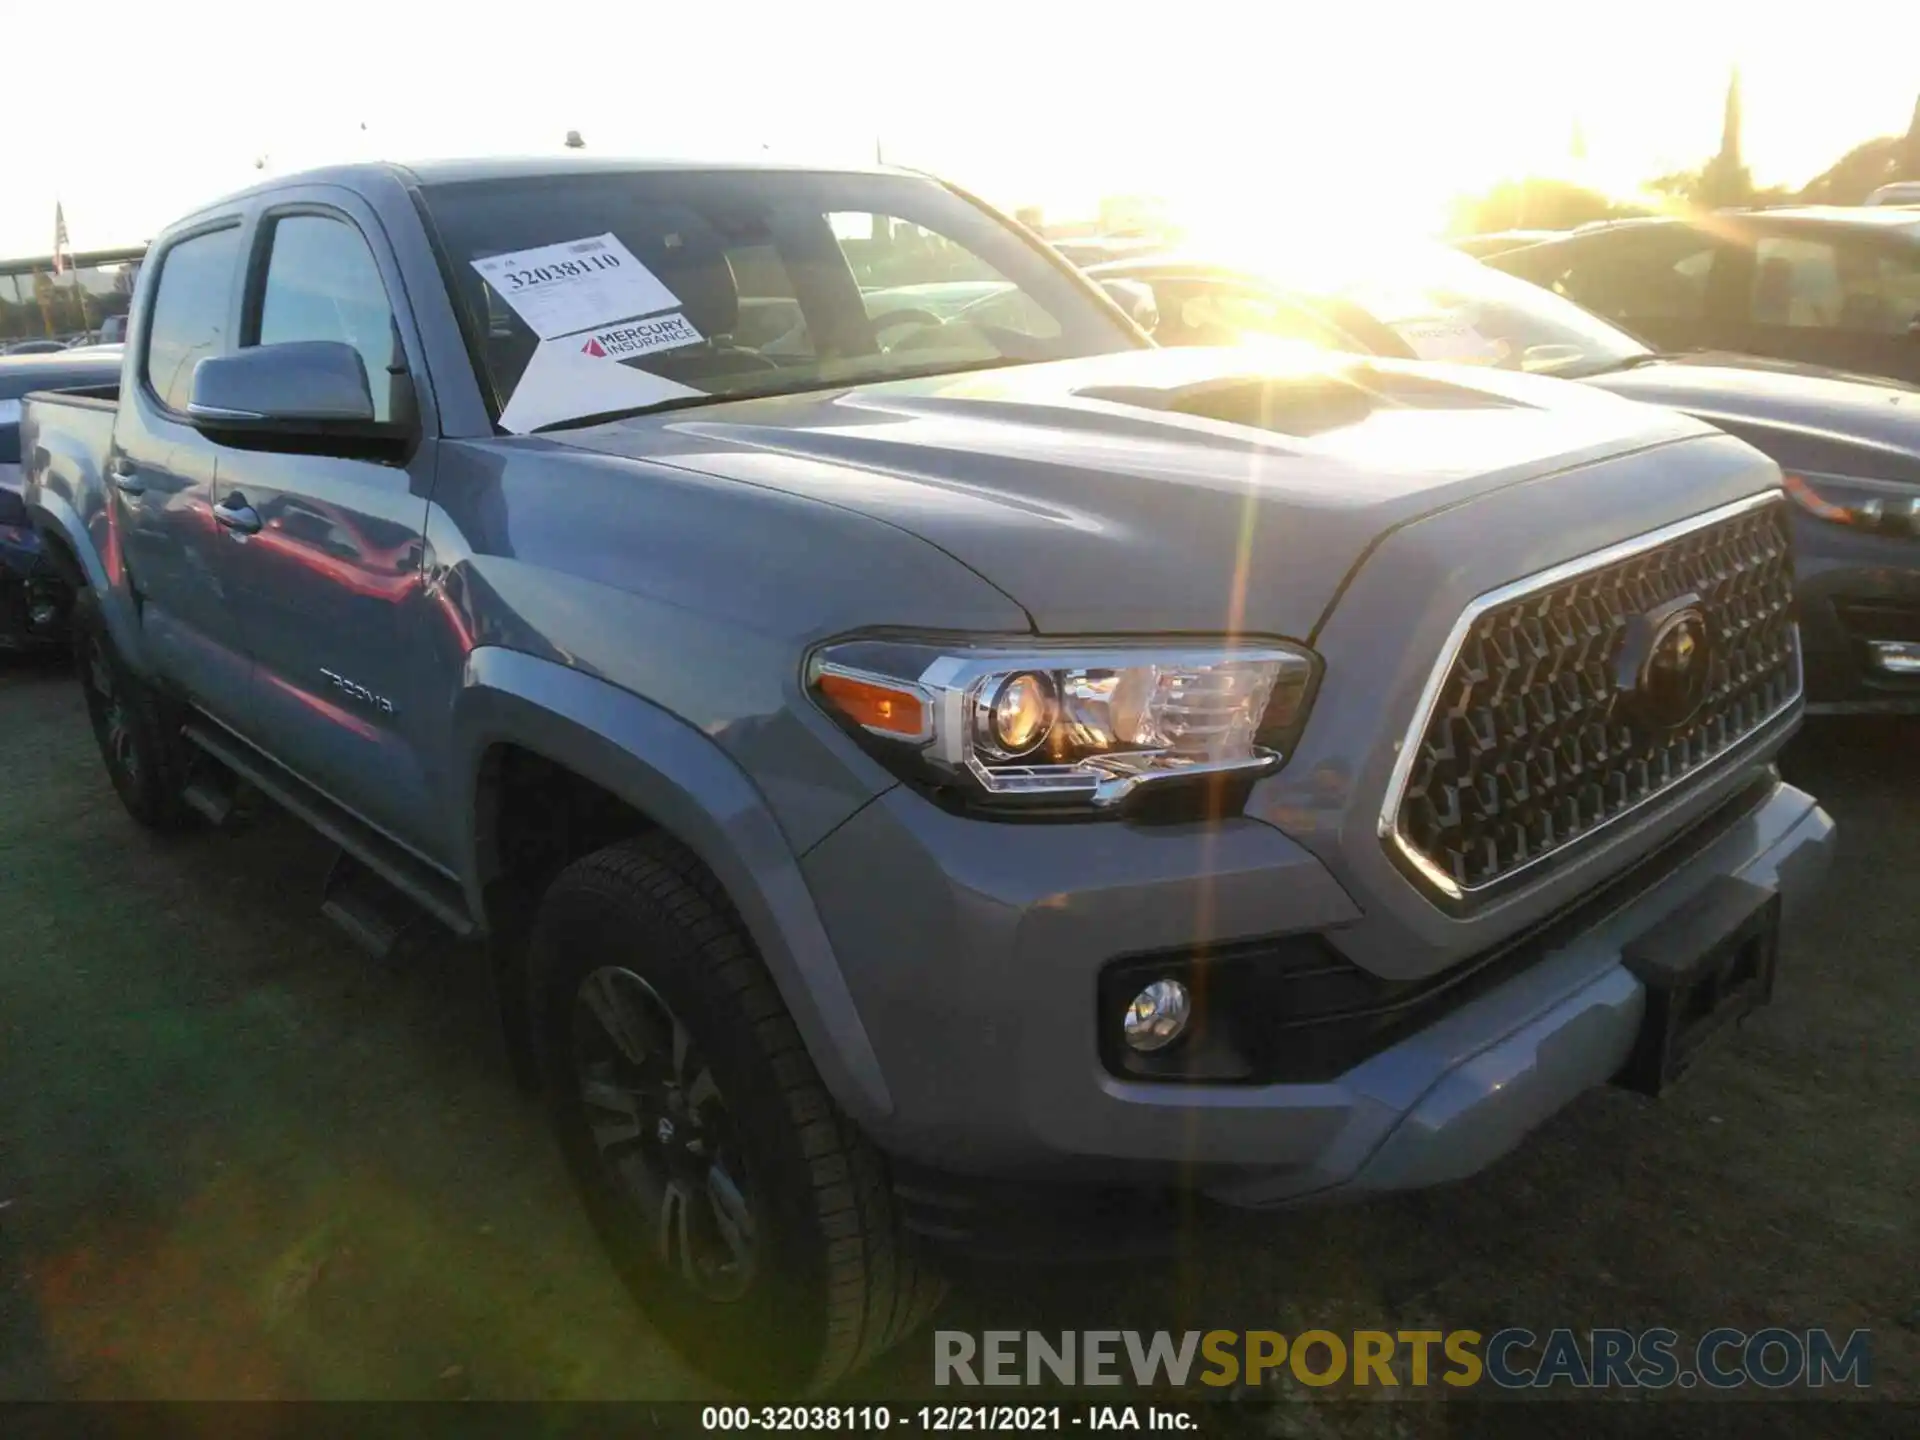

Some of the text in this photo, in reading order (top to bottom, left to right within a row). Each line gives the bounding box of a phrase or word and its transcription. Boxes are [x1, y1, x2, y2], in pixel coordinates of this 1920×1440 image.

[504, 254, 620, 288] 32038110
[597, 318, 685, 346] MERCURY
[605, 328, 696, 356] INSURANCE
